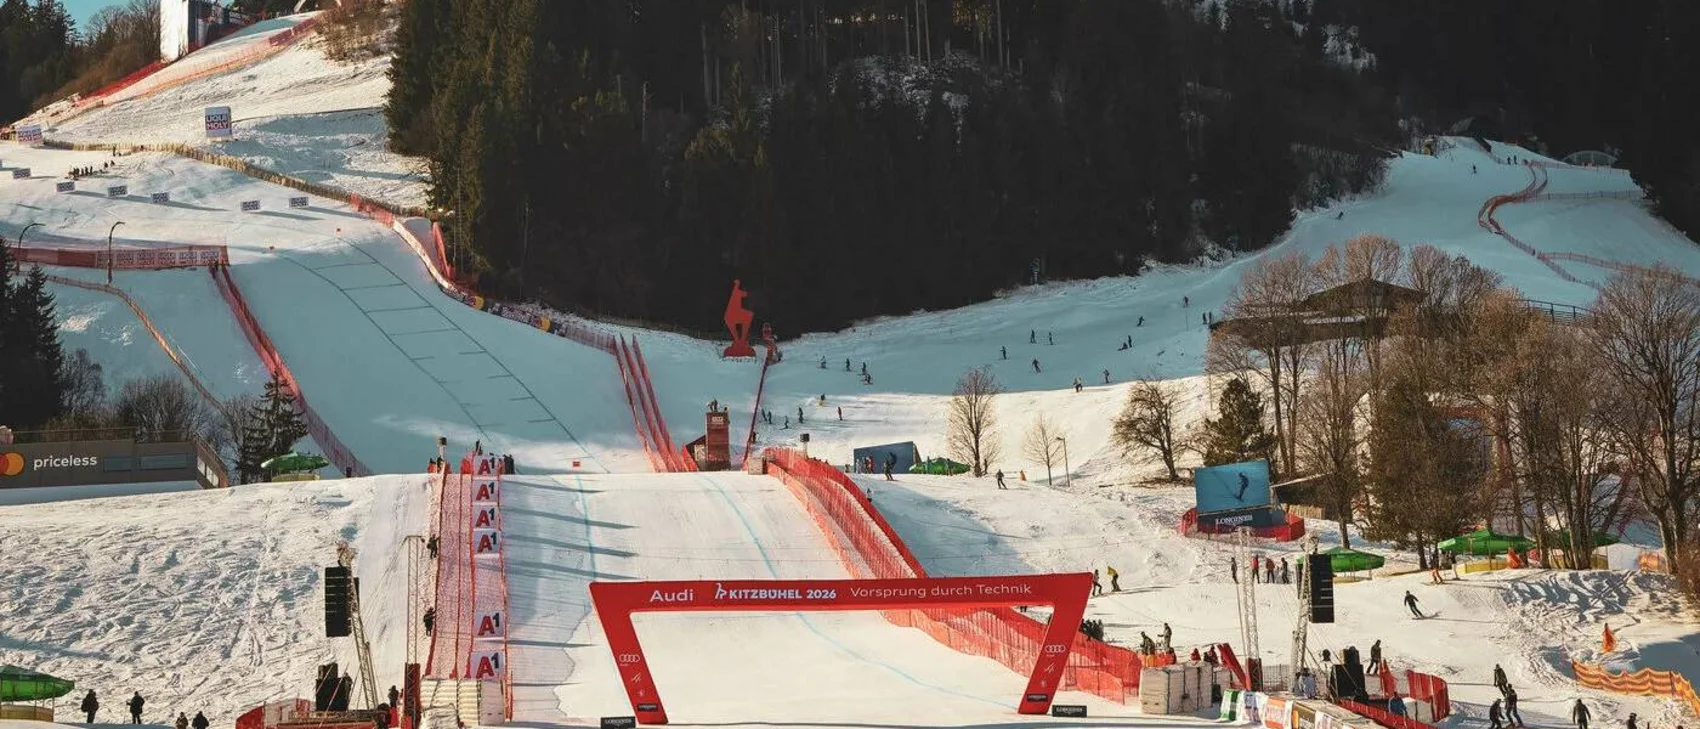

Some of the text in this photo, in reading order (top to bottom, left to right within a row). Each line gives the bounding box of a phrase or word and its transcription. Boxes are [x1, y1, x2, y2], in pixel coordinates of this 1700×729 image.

[206, 121, 228, 130] MOLY
[33, 454, 98, 471] priceless
[478, 457, 495, 475] A1
[475, 482, 495, 501] A1
[475, 507, 495, 527] A1
[477, 532, 497, 553] A1
[649, 589, 694, 602] Audi
[806, 588, 837, 600] 2026
[849, 587, 926, 599] Vorsprung
[930, 584, 973, 596] durch
[976, 582, 1032, 595] Technik
[477, 612, 500, 635] A1
[475, 652, 500, 679] A1
